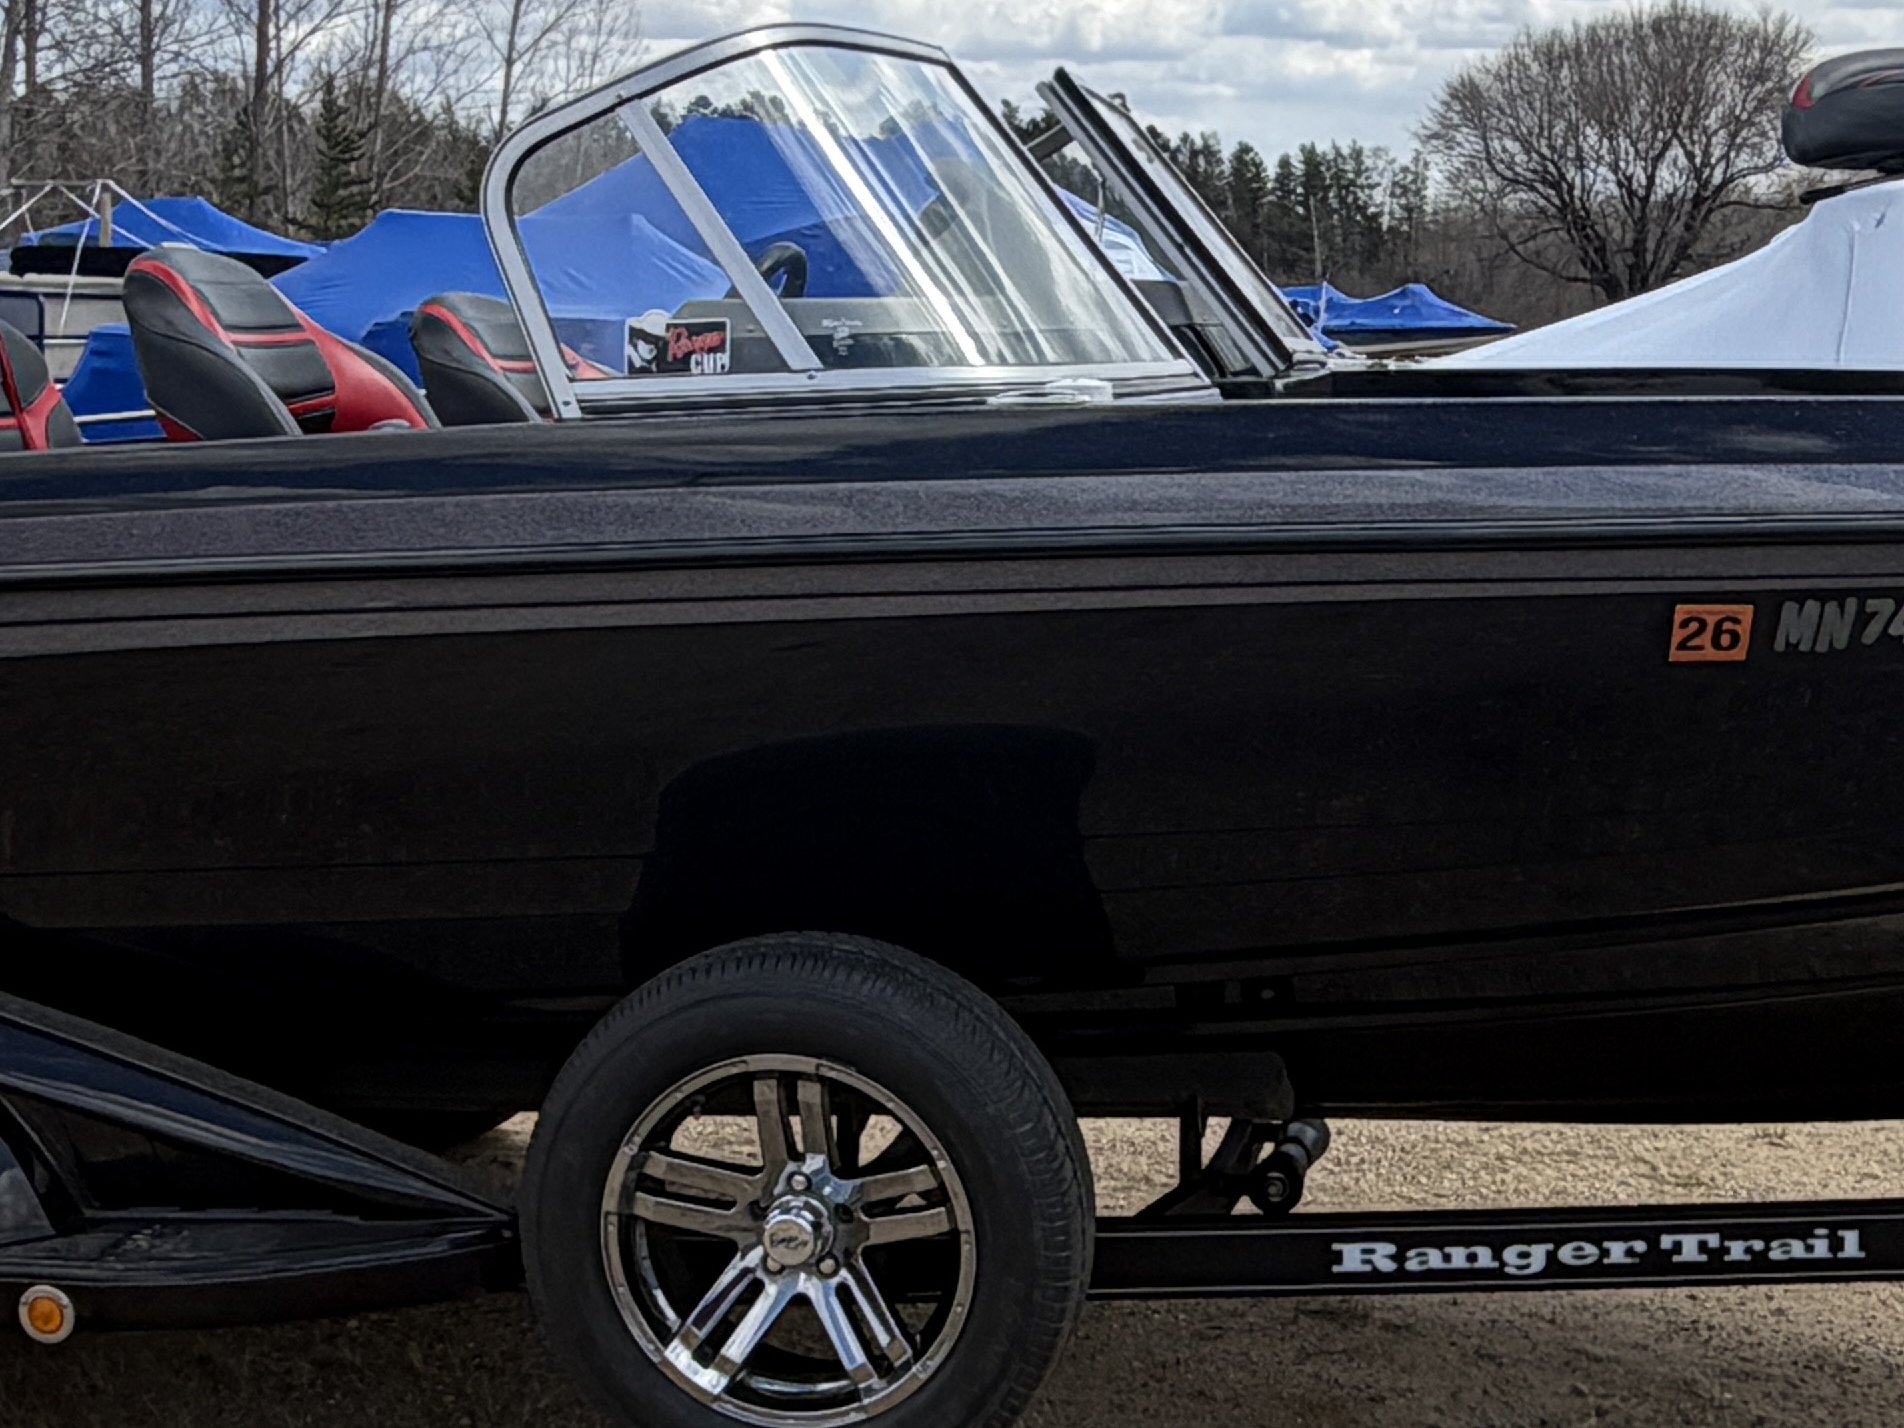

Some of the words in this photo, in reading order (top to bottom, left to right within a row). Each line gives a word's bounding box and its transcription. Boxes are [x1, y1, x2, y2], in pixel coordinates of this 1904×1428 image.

[1674, 615, 1742, 653] 26
[1330, 1239, 1647, 1276] Ranger
[1660, 1228, 1866, 1264] Trail
